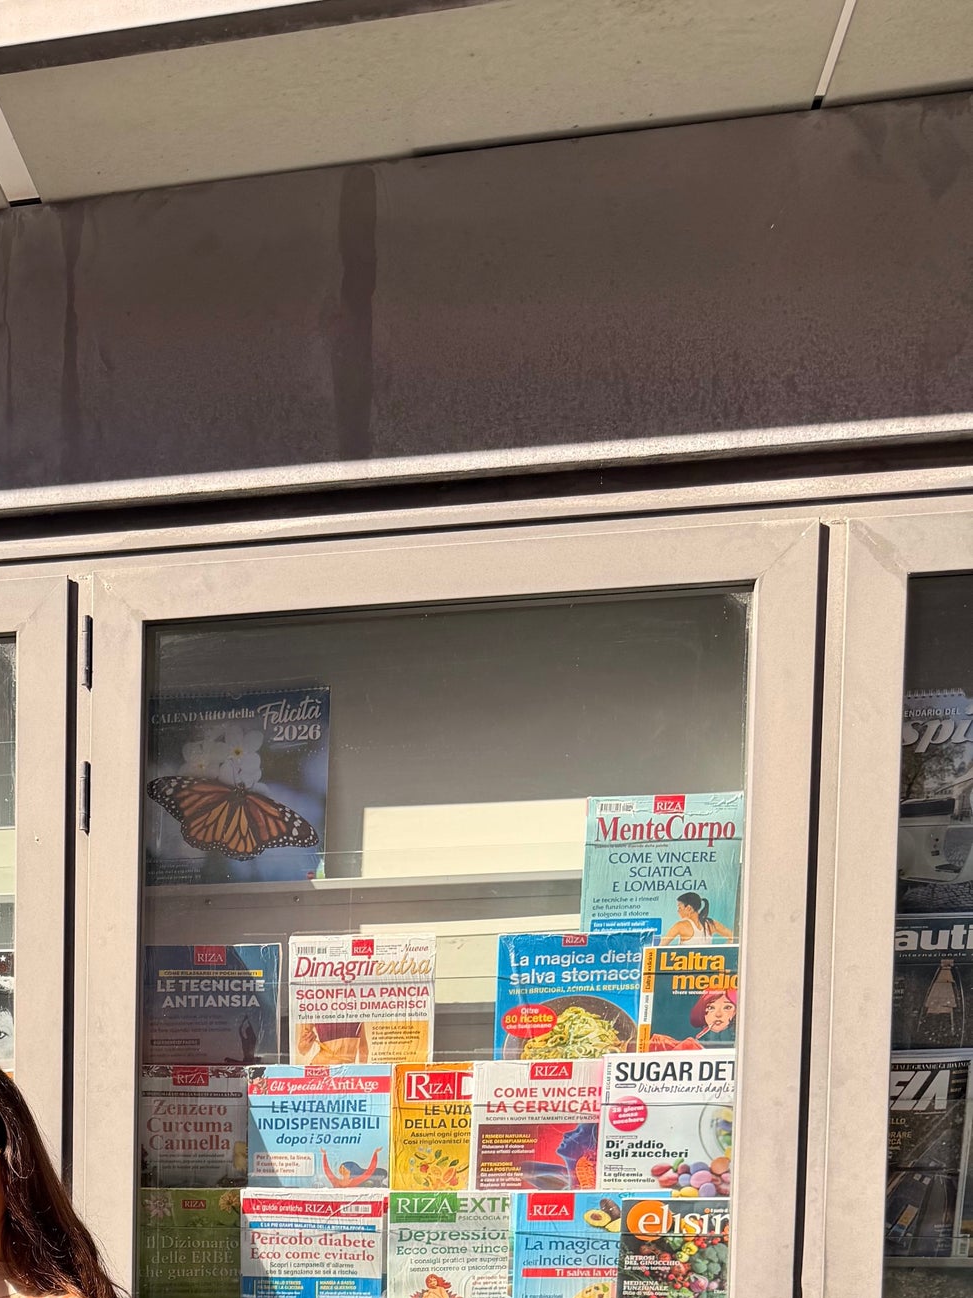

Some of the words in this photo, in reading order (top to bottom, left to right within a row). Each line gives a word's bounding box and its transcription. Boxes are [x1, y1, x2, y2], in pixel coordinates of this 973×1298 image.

[151, 710, 227, 724] CALENDARIO
[257, 696, 321, 730] Felicità
[944, 708, 961, 716] DEL
[273, 724, 321, 742] 2026
[595, 815, 736, 847] MenteCorpo
[608, 852, 653, 865] COME
[655, 851, 717, 864] VINCERE
[628, 866, 692, 878] SCIATICA
[624, 880, 708, 893] LOMBALGIA
[510, 953, 530, 968] La
[535, 951, 595, 967] magica
[600, 949, 642, 964] dieta
[509, 968, 555, 985] salva
[561, 967, 641, 982] stomaco
[157, 979, 176, 993] LE
[178, 979, 265, 992] TECNICHE
[296, 989, 356, 1000] SGONFIA
[360, 988, 376, 998] LA
[380, 986, 430, 998] PANCIA
[162, 995, 260, 1008] ANTIANSIA
[299, 1002, 328, 1012] SOLO
[360, 1000, 427, 1010] DIMAGRISCI
[534, 1066, 569, 1077] RIZA
[615, 1061, 693, 1082] SUGAR
[494, 1087, 537, 1098] COME
[638, 1082, 703, 1093] Disintossicarsi
[153, 1099, 227, 1117] Zenzero
[271, 1101, 288, 1113] LE
[291, 1100, 367, 1113] VITAMINE
[424, 1105, 440, 1116] LE
[486, 1101, 508, 1113] LA
[147, 1118, 233, 1133] Curcuma
[258, 1117, 380, 1130] INDISPENSABILI
[404, 1119, 447, 1129] DELLA
[149, 1135, 231, 1151] Cannella
[276, 1133, 307, 1147] dopo
[315, 1133, 331, 1144] 50
[333, 1133, 361, 1144] anni
[627, 1140, 664, 1149] addio
[631, 1149, 689, 1158] zuccheri
[396, 1197, 454, 1214] RIZA
[162, 1235, 239, 1249] Dizionario
[250, 1231, 313, 1246] Pericolo
[318, 1233, 376, 1249] diabete
[525, 1238, 544, 1251] La
[548, 1238, 608, 1256] magica
[250, 1248, 281, 1260] Ecco
[285, 1251, 321, 1260] come
[324, 1249, 375, 1262] evitarlo
[396, 1246, 428, 1256] Ecco
[431, 1245, 467, 1255] come
[472, 1243, 509, 1254] vince
[151, 1251, 188, 1264] delle
[191, 1251, 234, 1264] ERBE
